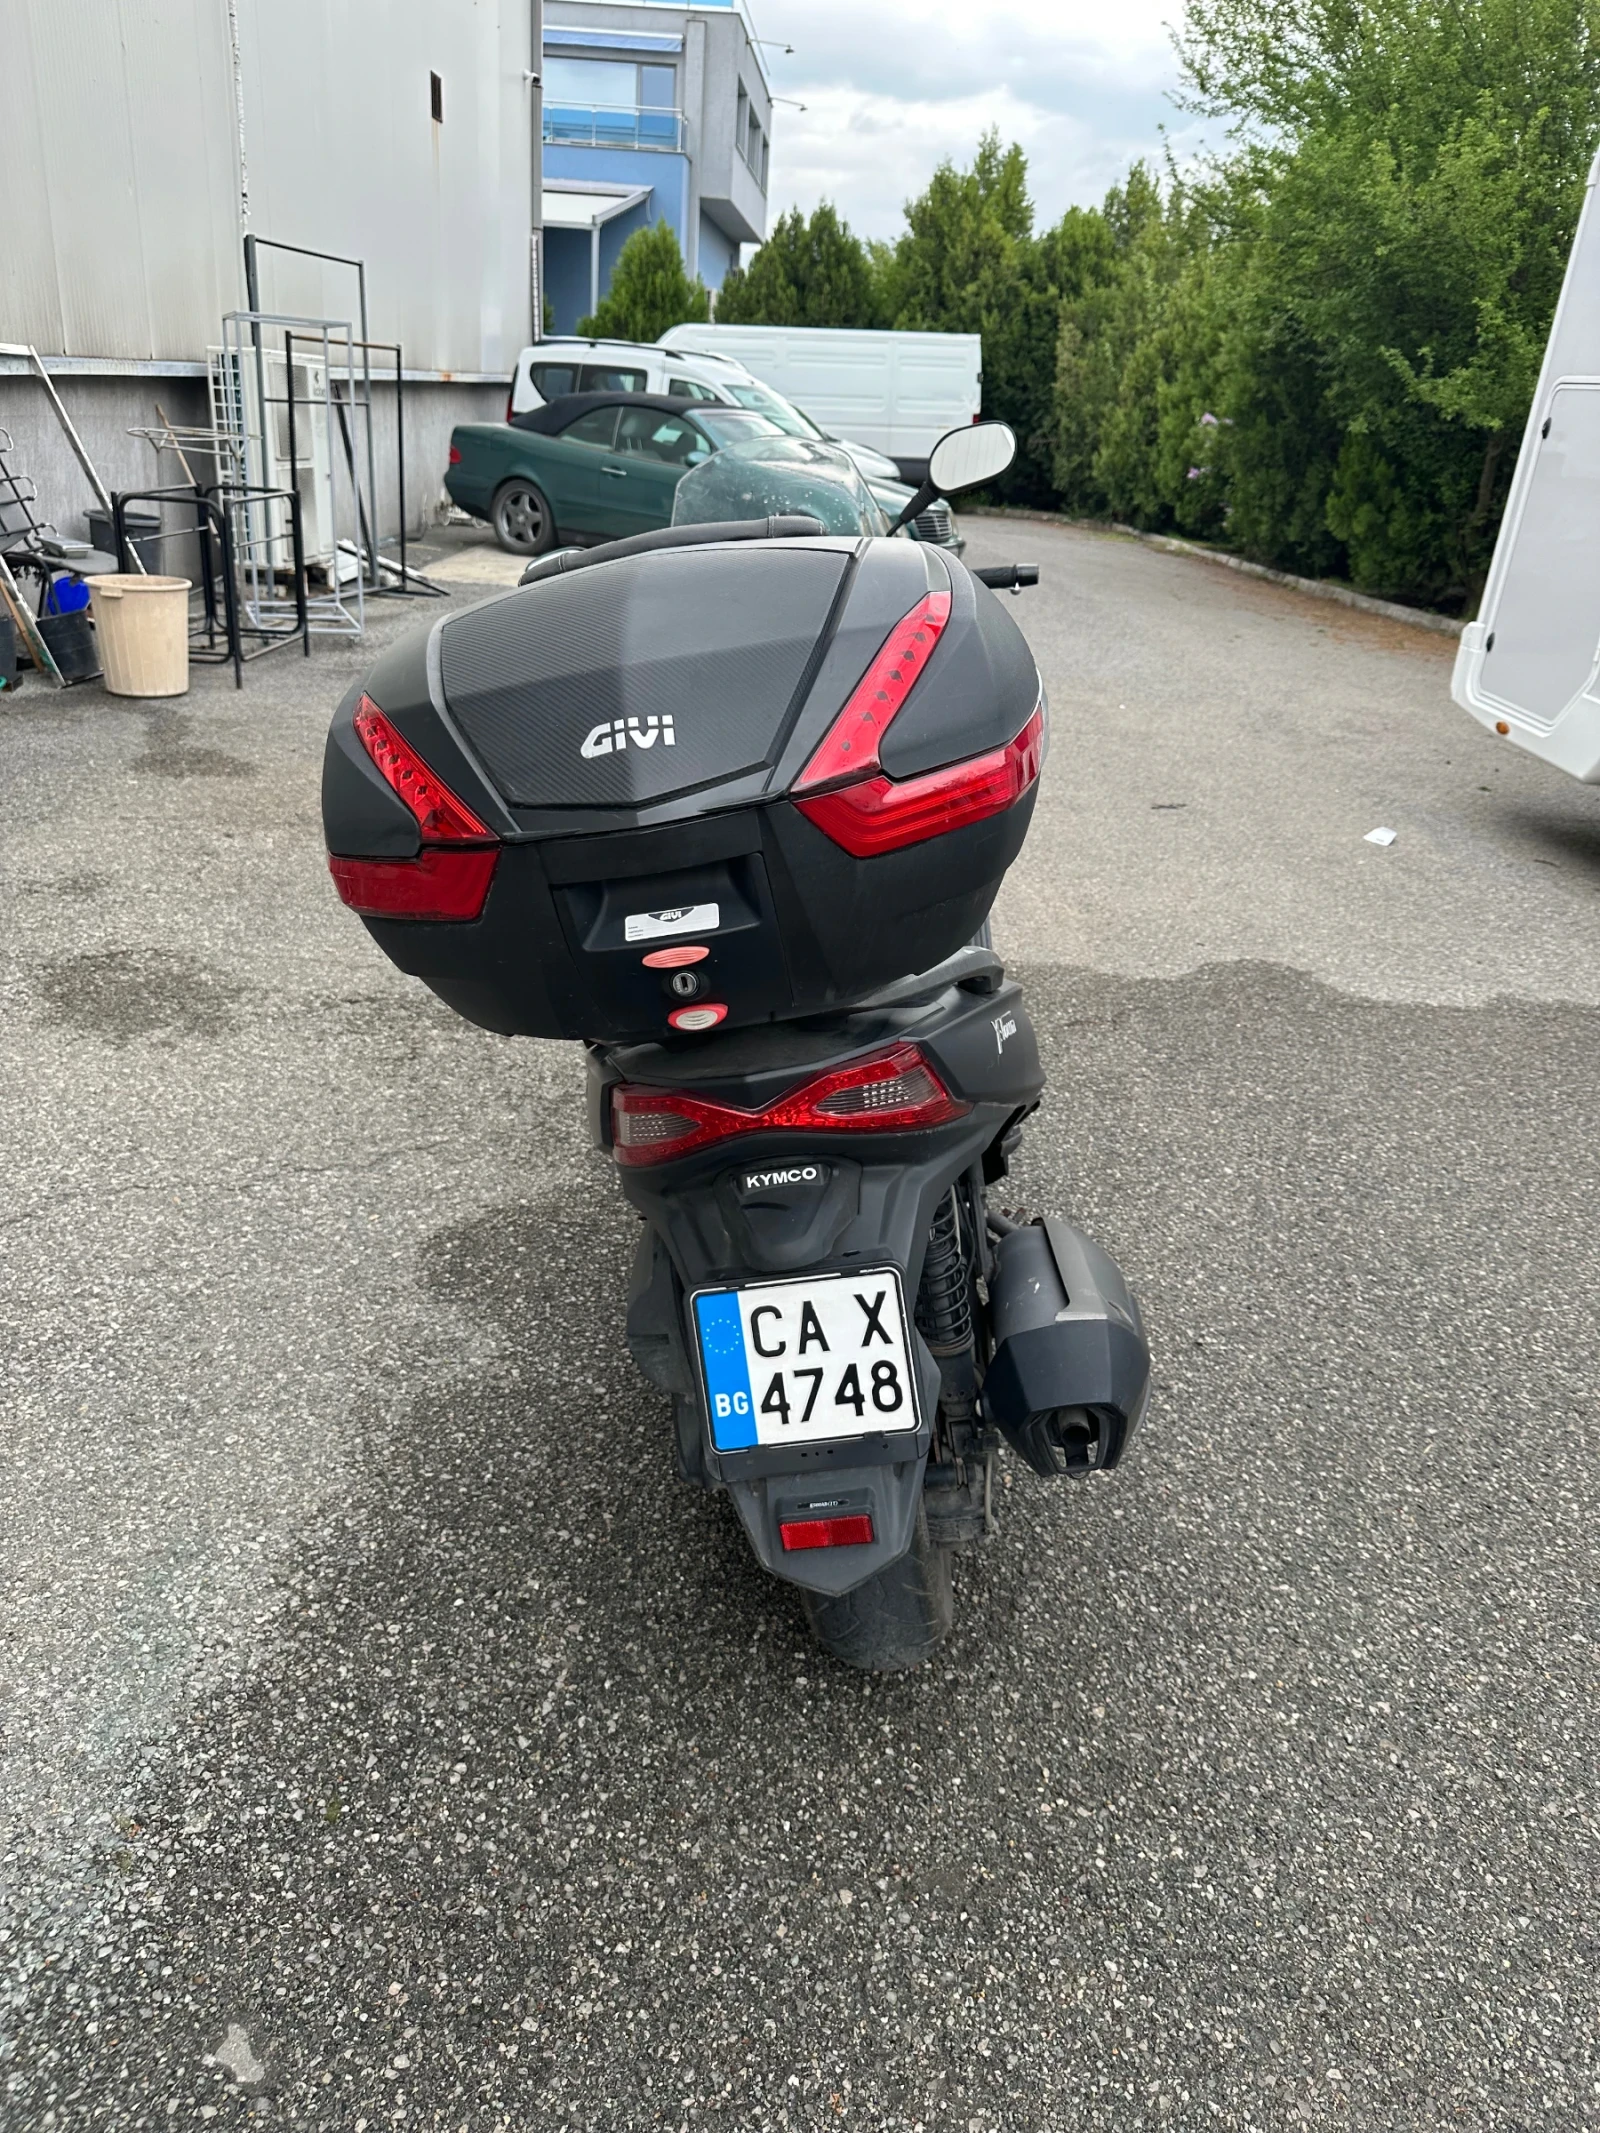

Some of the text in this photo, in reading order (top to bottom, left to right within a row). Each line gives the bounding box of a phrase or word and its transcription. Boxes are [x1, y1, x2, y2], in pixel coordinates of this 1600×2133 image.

[580, 714, 676, 759] GIVI
[659, 910, 683, 921] GIVI
[746, 1167, 817, 1188] KYMCO
[750, 1290, 894, 1358] CA X
[715, 1391, 749, 1417] BG
[761, 1360, 904, 1425] 4748
